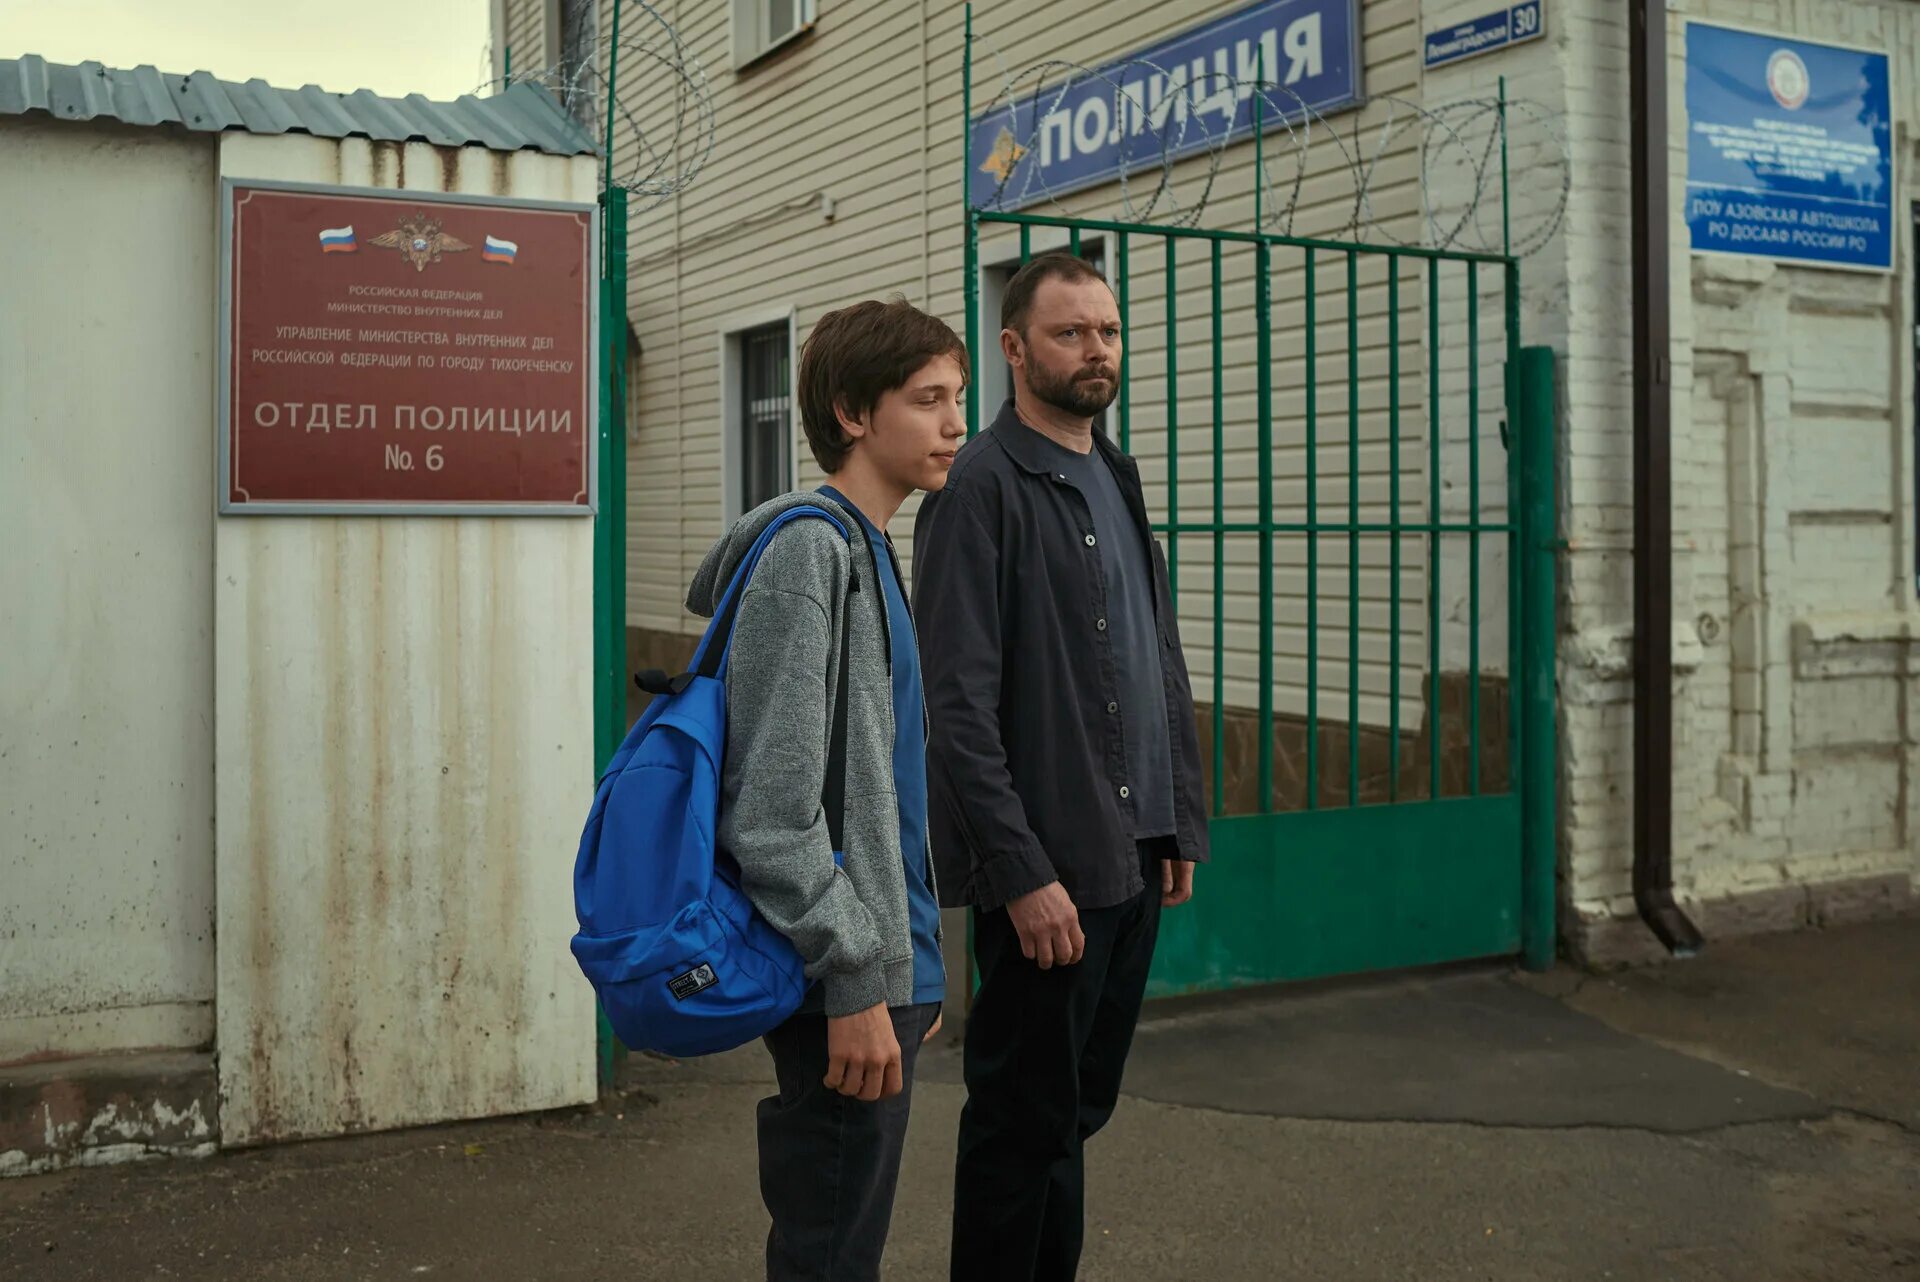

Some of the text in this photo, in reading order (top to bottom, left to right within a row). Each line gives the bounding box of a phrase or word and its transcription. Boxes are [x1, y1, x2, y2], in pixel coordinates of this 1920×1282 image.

[1514, 5, 1537, 35] 30
[1039, 11, 1323, 167] ПОЛИЦИЯ
[1726, 203, 1799, 225] АЗОВСКАЯ
[1801, 211, 1880, 233] АВТОШКОЛА
[1708, 221, 1867, 252] РО ДОСААФ РОССИИ РО
[349, 285, 483, 301] РОССИЙСКАЯ ФЕДЕРАЦИЯ
[327, 302, 503, 320] МИНИСТЕРСТВО ВНУТРЕННИХ ДЕЛ
[276, 326, 554, 351] УПРАВЛЕНИЕ МИНИСТЕРСТВА ВНУТРЕННИХ ДЕЛ
[252, 348, 574, 374] РОССИЙСКОЙ ФЕДЕРАЦИИ ПО ГОРОДУ ТИХОРЕЧЕНСКУ
[254, 402, 572, 438] ОТДЕЛ ПОЛИЦИИ
[425, 444, 445, 471] 6
